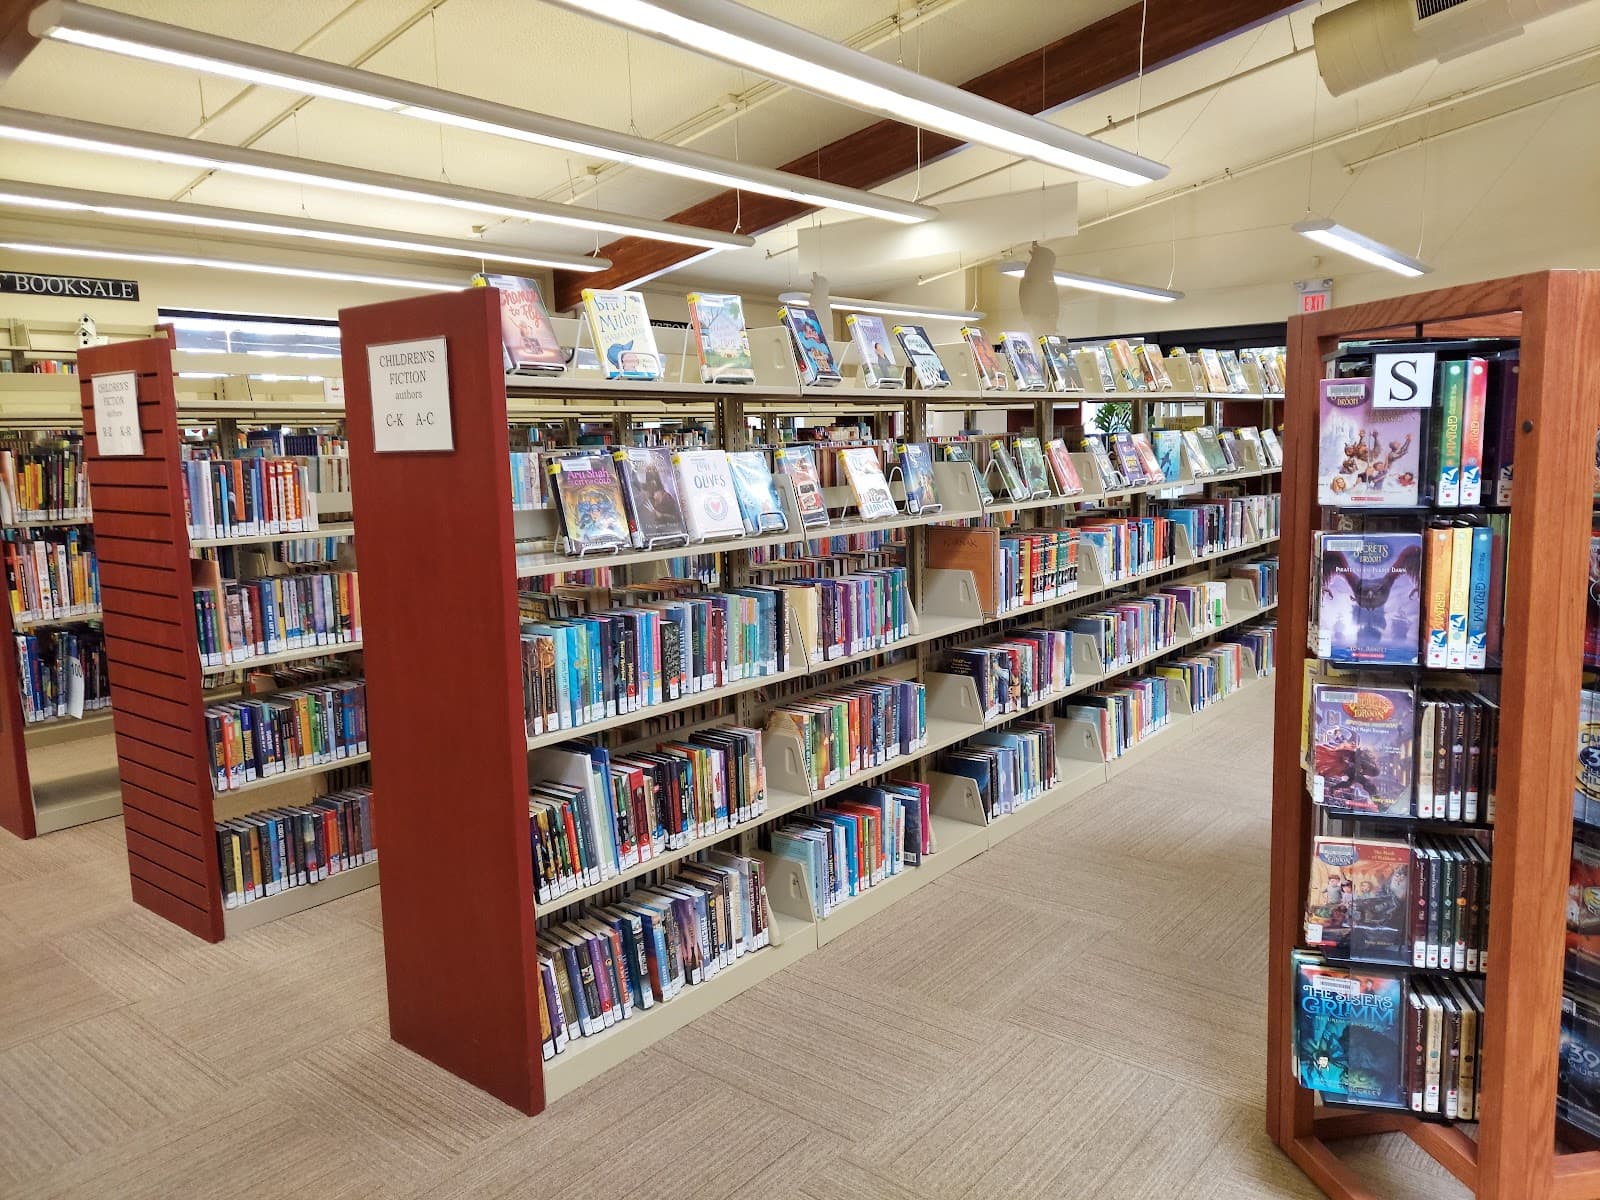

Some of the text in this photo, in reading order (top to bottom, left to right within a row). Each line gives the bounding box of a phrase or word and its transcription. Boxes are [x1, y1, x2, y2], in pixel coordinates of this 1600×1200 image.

[15, 275, 134, 298] BOOKSALE
[1304, 295, 1325, 311] EXIT
[599, 312, 638, 332] Miller
[379, 350, 435, 368] CHILDREN'S
[389, 370, 426, 385] FICTION
[1389, 360, 1418, 401] S
[395, 389, 423, 400] authors
[386, 412, 434, 427] C-K A-C
[1445, 416, 1457, 457] GRIMM
[587, 466, 610, 479] Shah
[694, 473, 726, 489] OLIVES
[1473, 582, 1487, 622] GRIMM
[1354, 708, 1384, 719] DROON
[700, 917, 708, 946] FRIEND
[1303, 985, 1393, 1011] THE SISTERS
[1301, 996, 1395, 1026] GRIMM
[1568, 1043, 1600, 1069] 39
